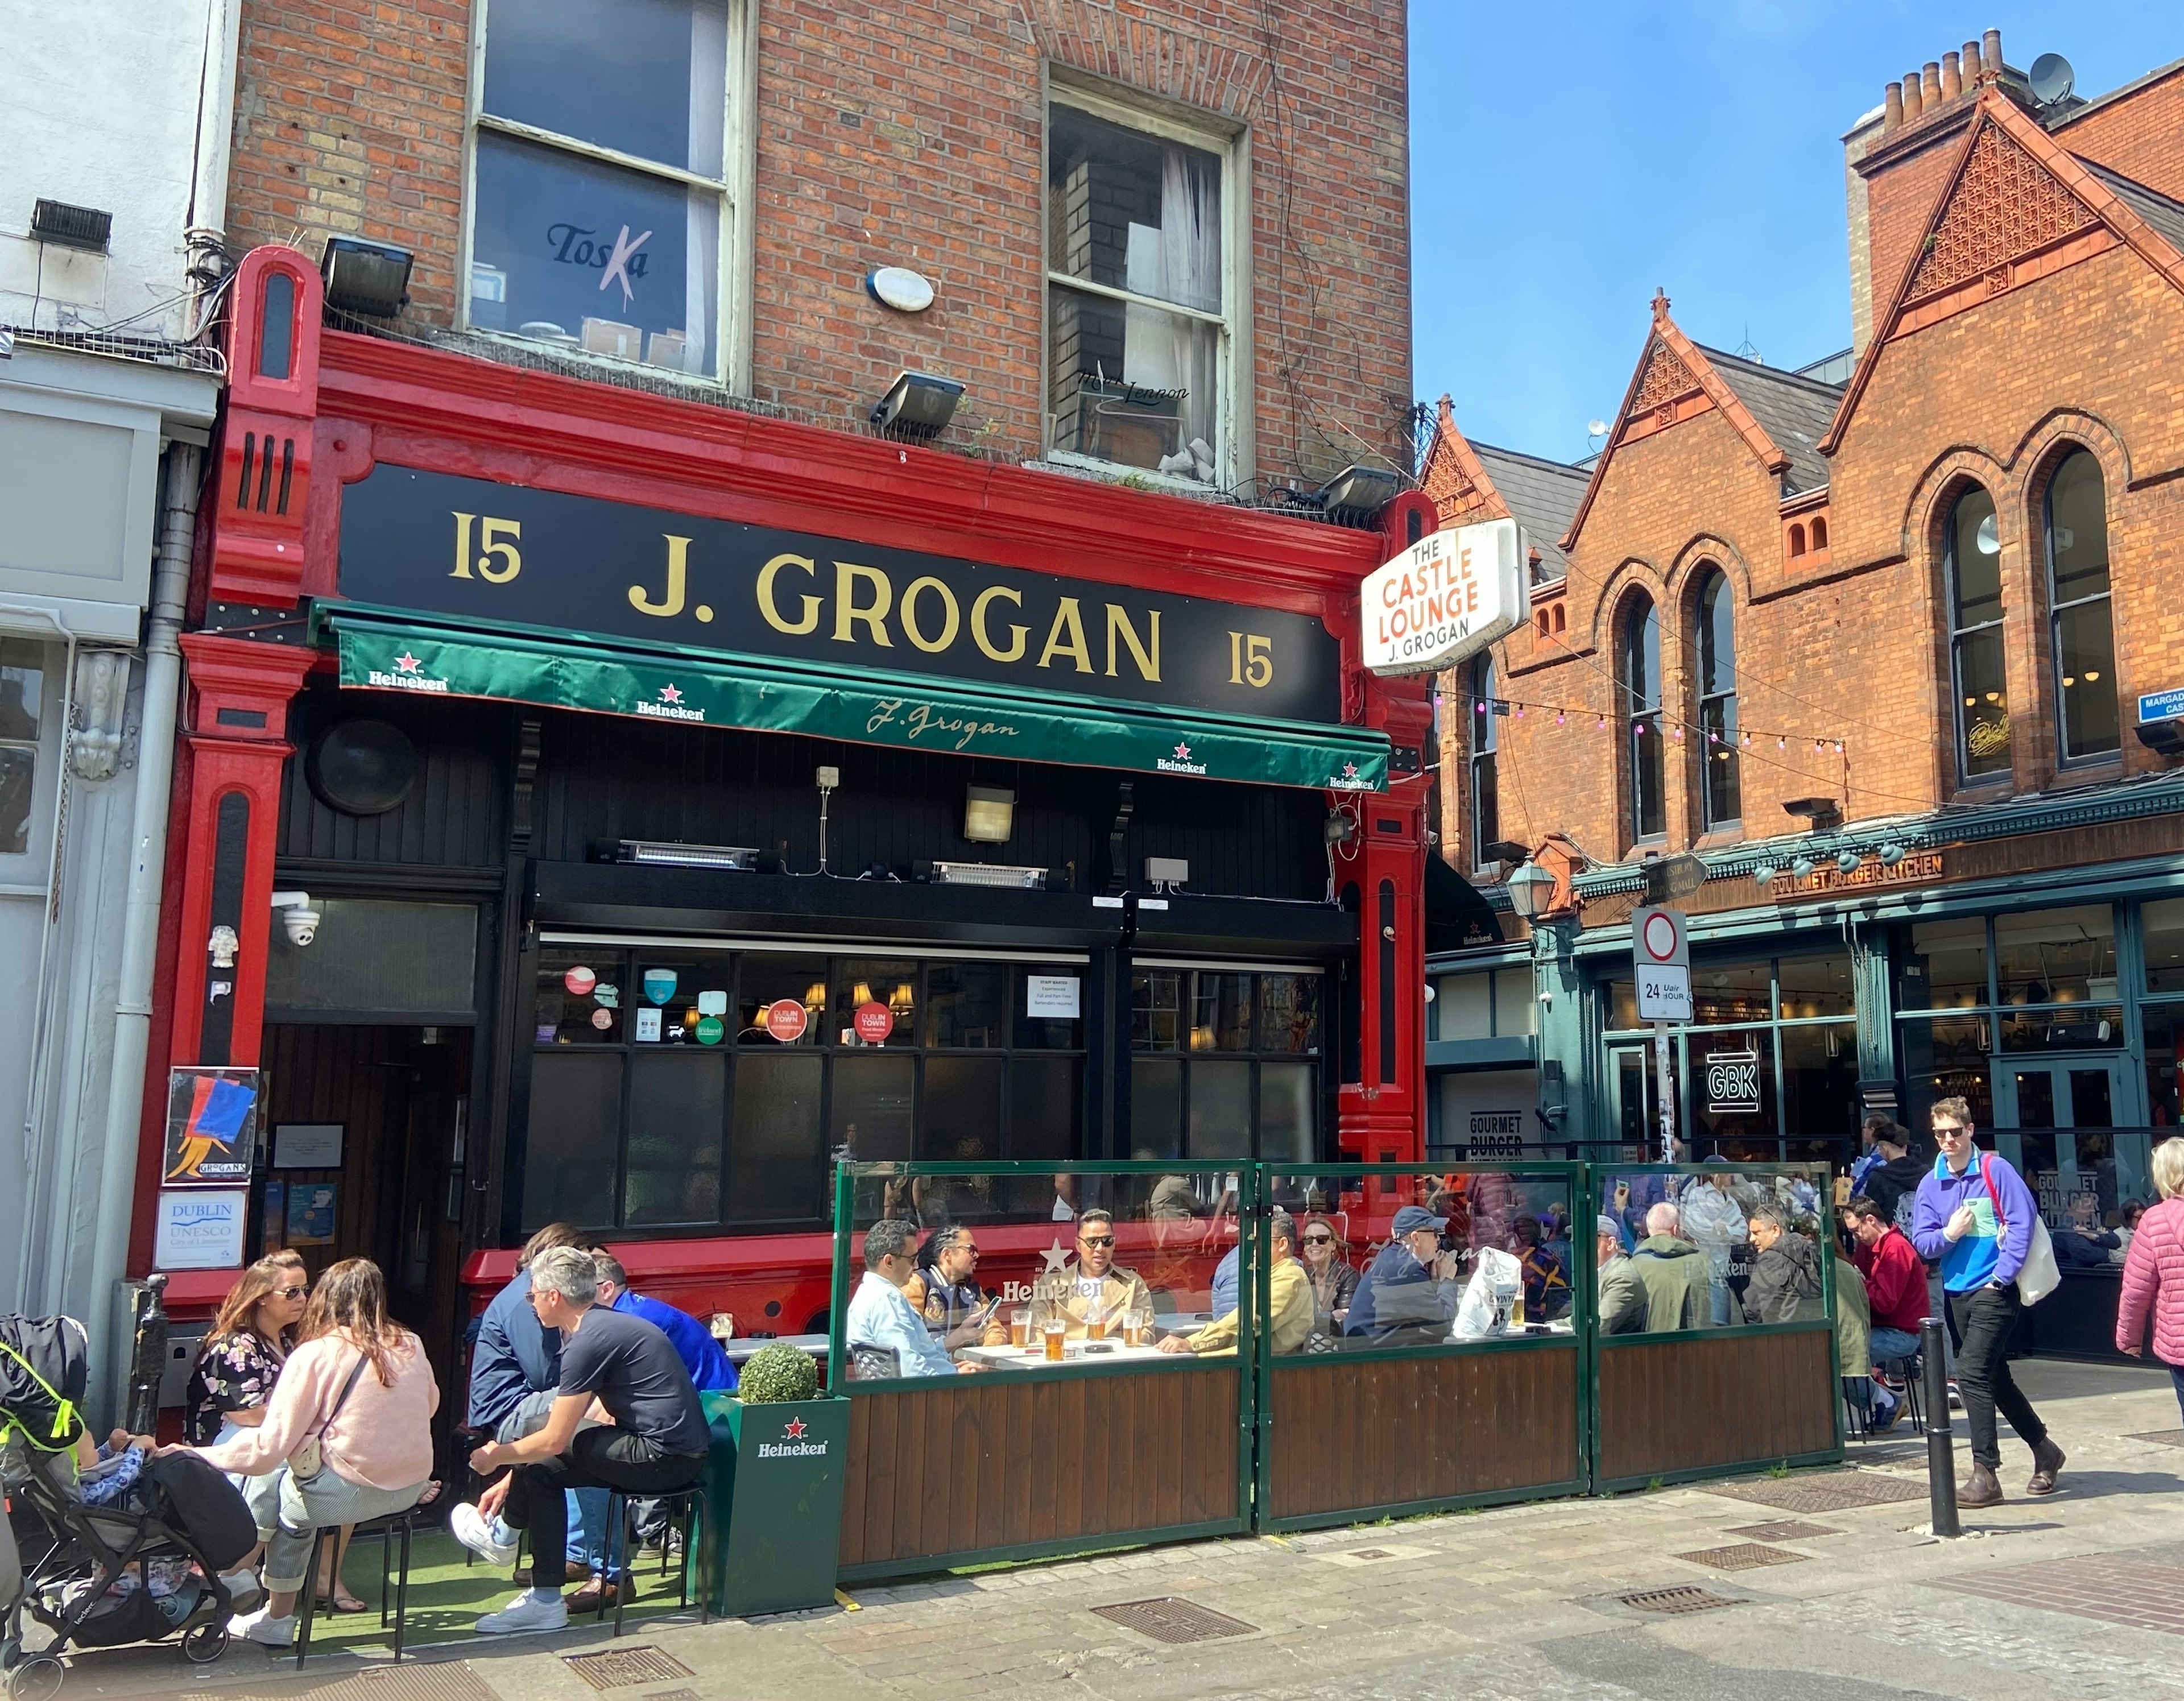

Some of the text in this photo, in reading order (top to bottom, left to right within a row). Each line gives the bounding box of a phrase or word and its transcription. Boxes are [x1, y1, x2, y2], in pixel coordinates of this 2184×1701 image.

[1125, 382, 1189, 406] Lennon
[1413, 539, 1439, 565] THE
[1383, 548, 1472, 609] CASTLE
[448, 511, 1273, 688] 15 J. GROGAN 15
[1379, 581, 1478, 644] LOUNGE
[1388, 618, 1469, 662] J. GROGAN
[369, 671, 448, 691] Heineken
[637, 701, 705, 721] Heineken
[2166, 703, 2184, 714] CAS
[1157, 759, 1206, 774] Heineken
[1330, 777, 1374, 789] Heineken
[1678, 878, 1697, 891] MALL
[1463, 933, 1493, 945] Heineken
[1646, 983, 1660, 999] 24
[1708, 1065, 1757, 1099] GBK
[1470, 1116, 1521, 1133] GOURMET
[1471, 1136, 1522, 1156] BURGER
[200, 1164, 246, 1173] GROGANS
[172, 1205, 232, 1216] DUBLIN
[2039, 1191, 2099, 1211] BURGER
[171, 1227, 231, 1238] UNESCO
[170, 1239, 185, 1247] City
[1003, 1280, 1103, 1302] Heineken
[758, 1441, 828, 1457] Heineken
[73, 1601, 97, 1625] leclerc
